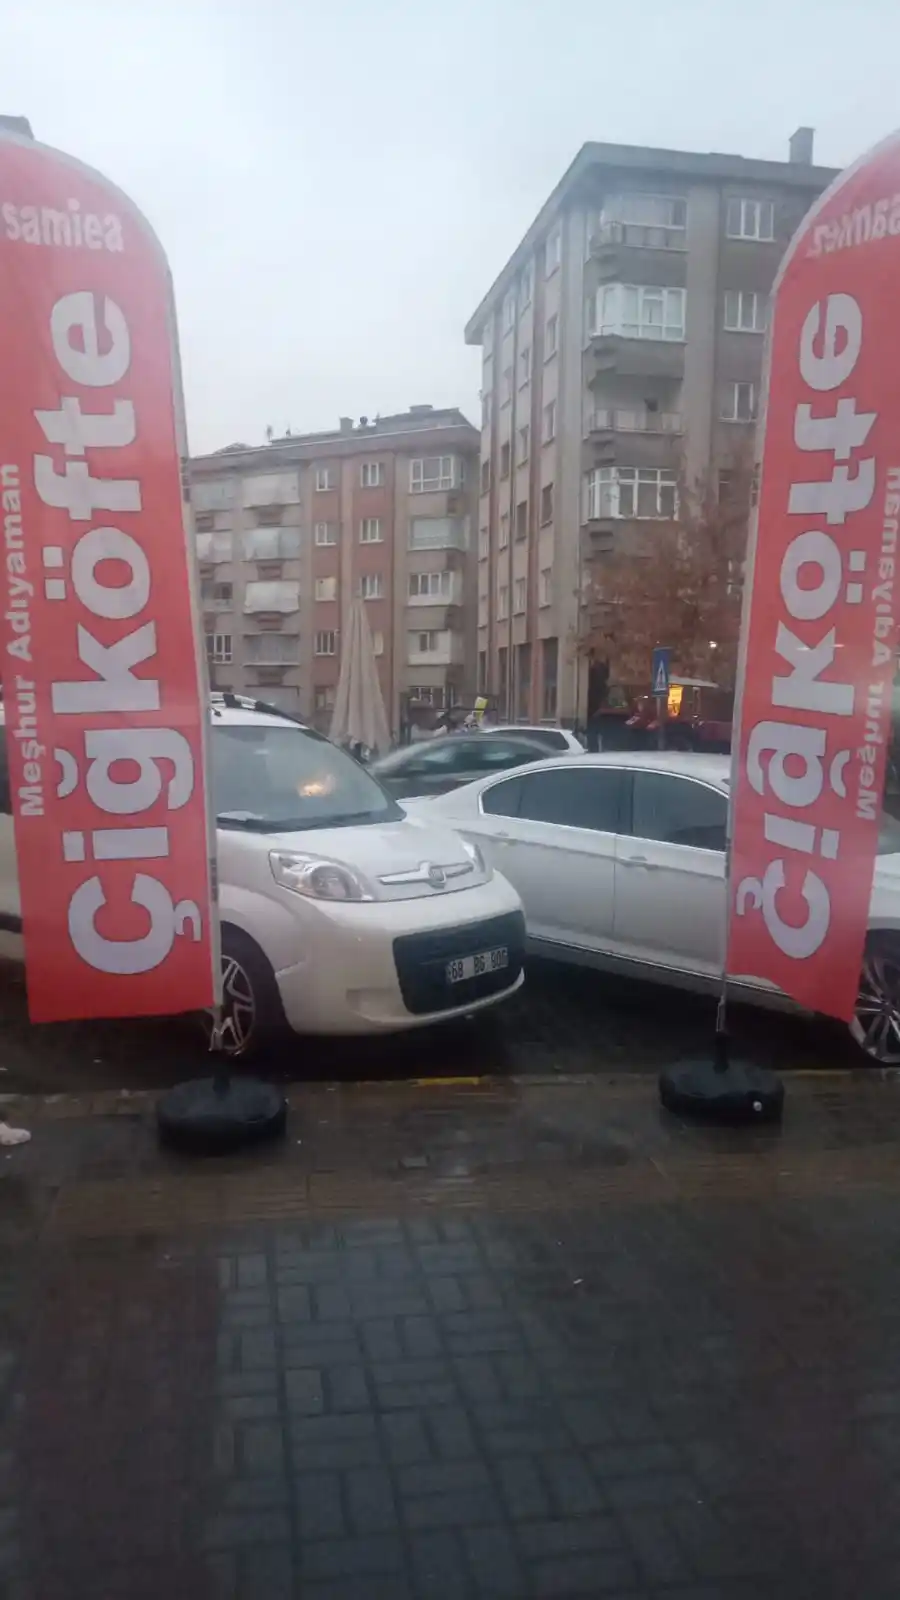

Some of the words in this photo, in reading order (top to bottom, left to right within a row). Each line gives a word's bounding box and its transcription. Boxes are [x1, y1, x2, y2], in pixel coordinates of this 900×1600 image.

[1, 198, 125, 252] samiea
[1, 463, 33, 662] Adıyaman
[33, 291, 201, 975] Çiğköfte
[14, 675, 46, 817] Meşhur
[451, 960, 464, 979] 68
